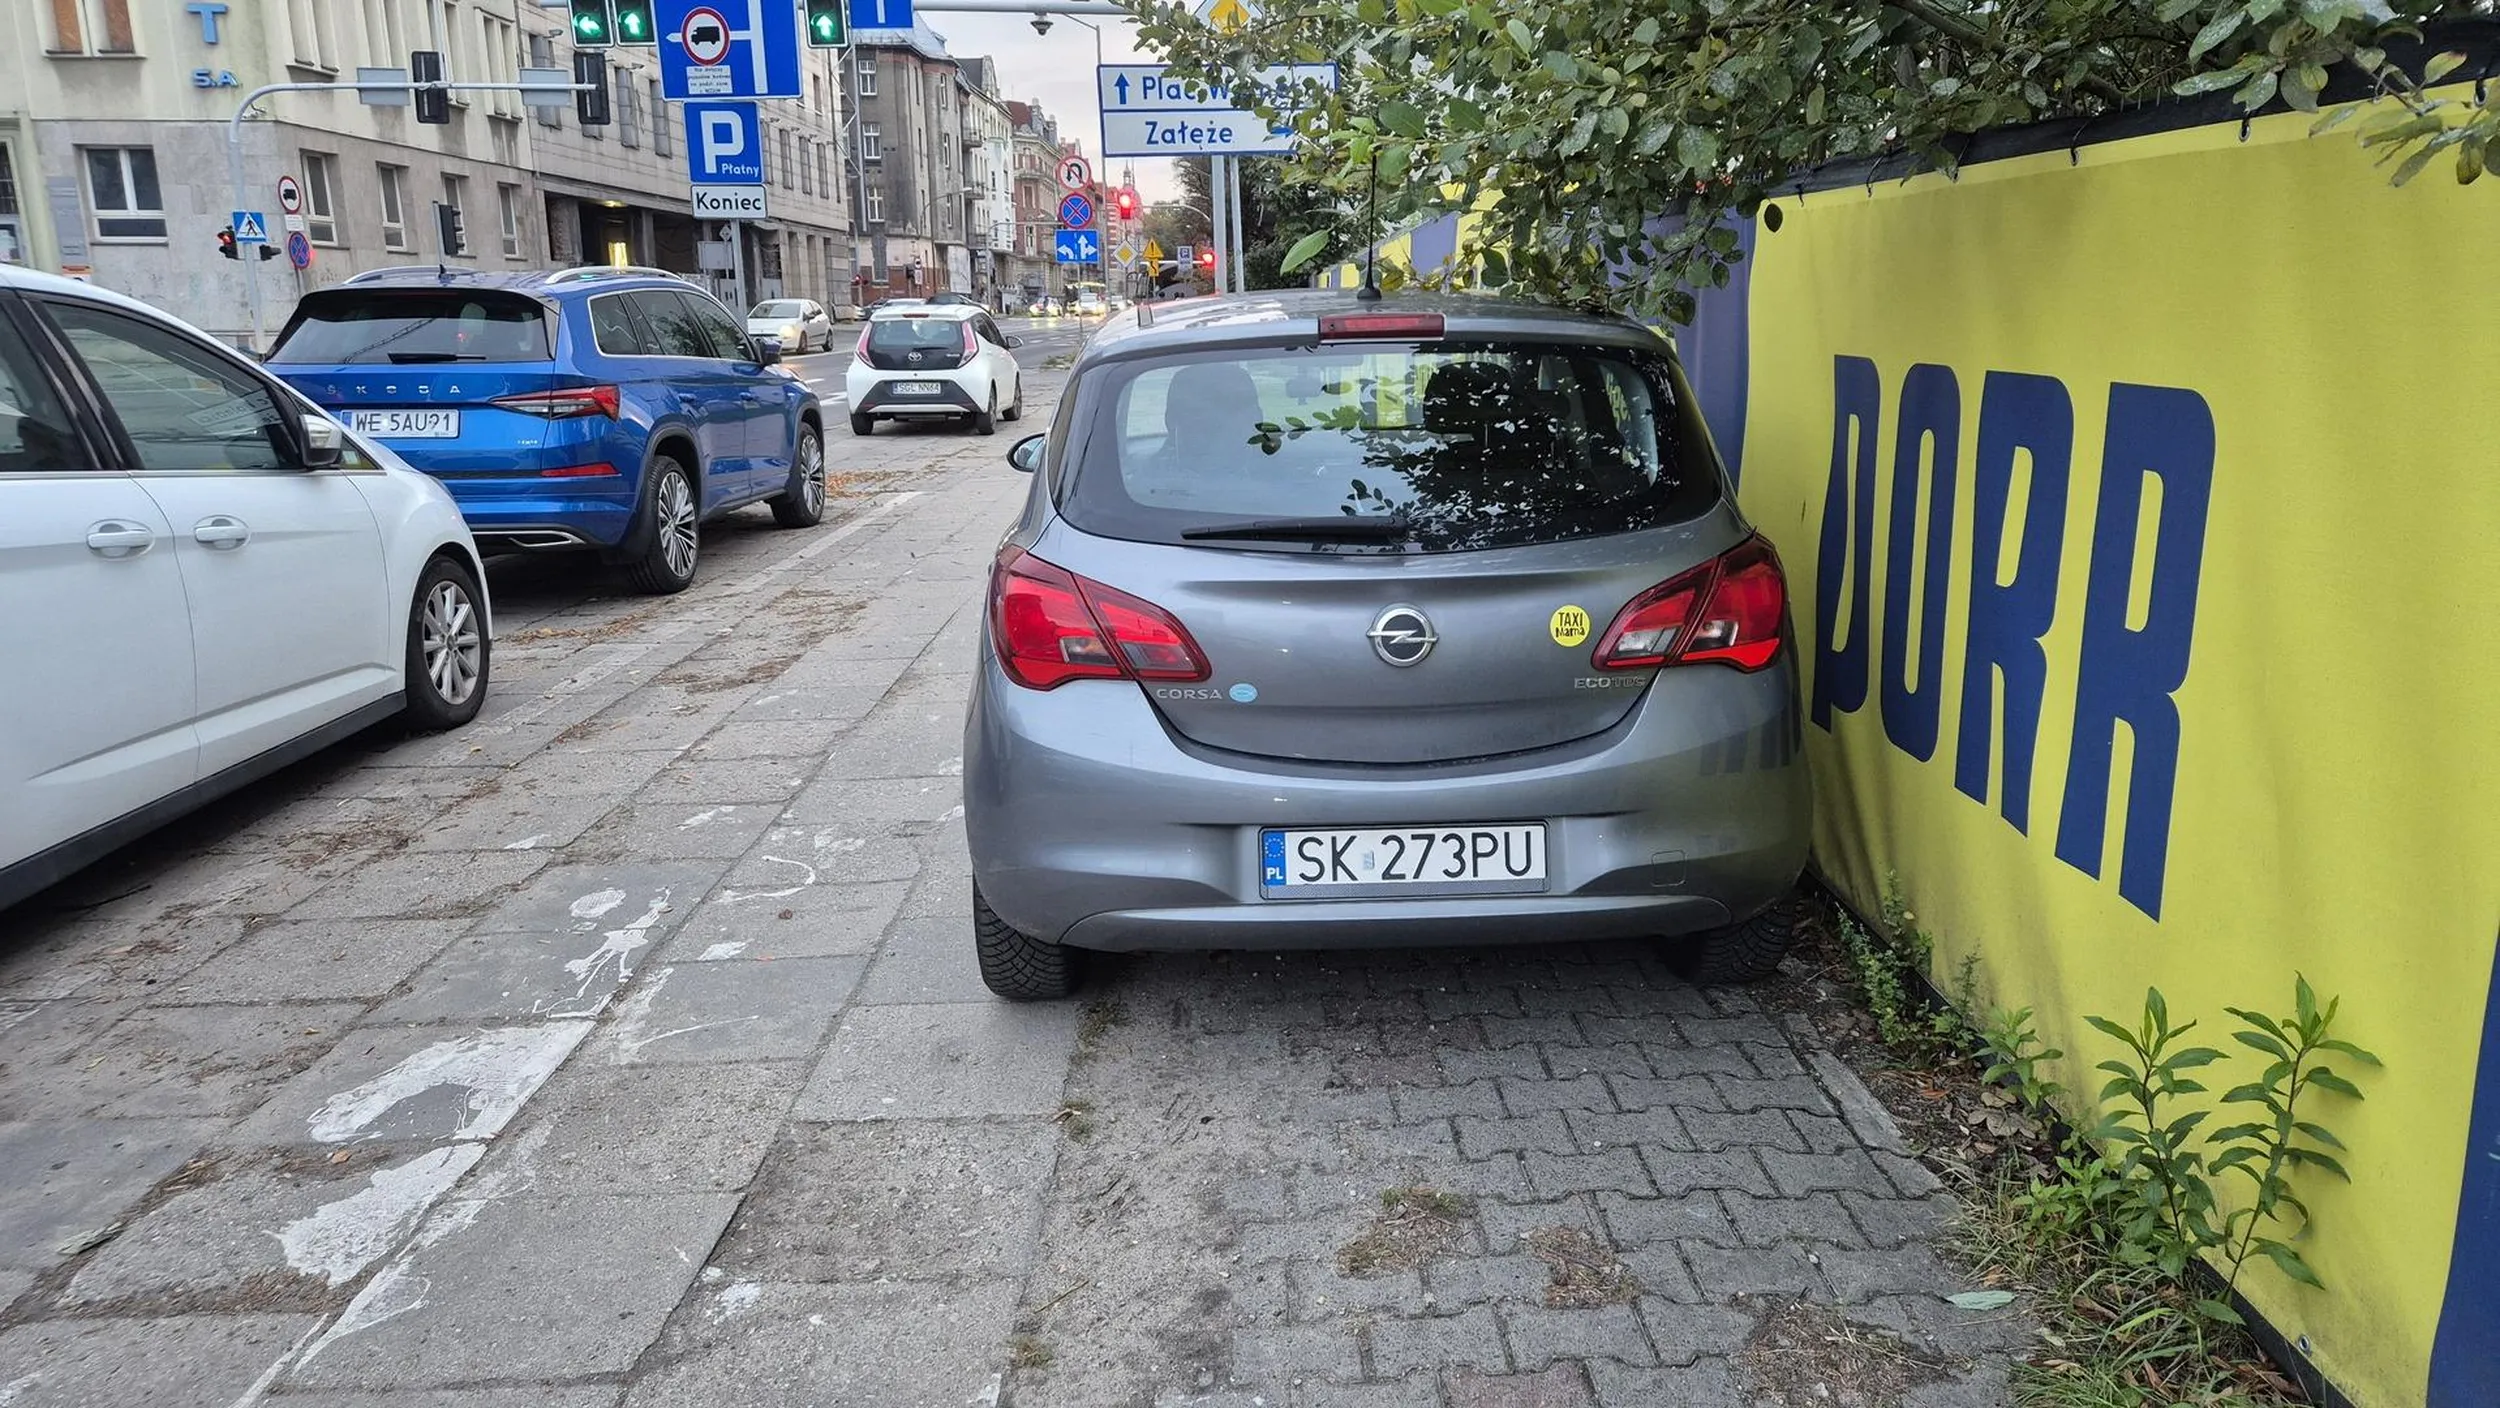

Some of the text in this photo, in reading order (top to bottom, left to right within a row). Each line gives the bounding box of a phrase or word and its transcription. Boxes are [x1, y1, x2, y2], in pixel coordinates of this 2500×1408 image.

[700, 110, 744, 174] P
[1145, 120, 1233, 146] Załeże
[721, 163, 760, 178] Płatny
[696, 191, 762, 210] Koniec
[356, 413, 381, 432] WE
[1558, 612, 1583, 627] TAXI
[1555, 626, 1586, 638] Mama
[1811, 354, 2216, 923] PORR
[1156, 688, 1223, 700] CORSA
[1297, 831, 1532, 883] SK 273PU
[1266, 868, 1283, 881] PL
